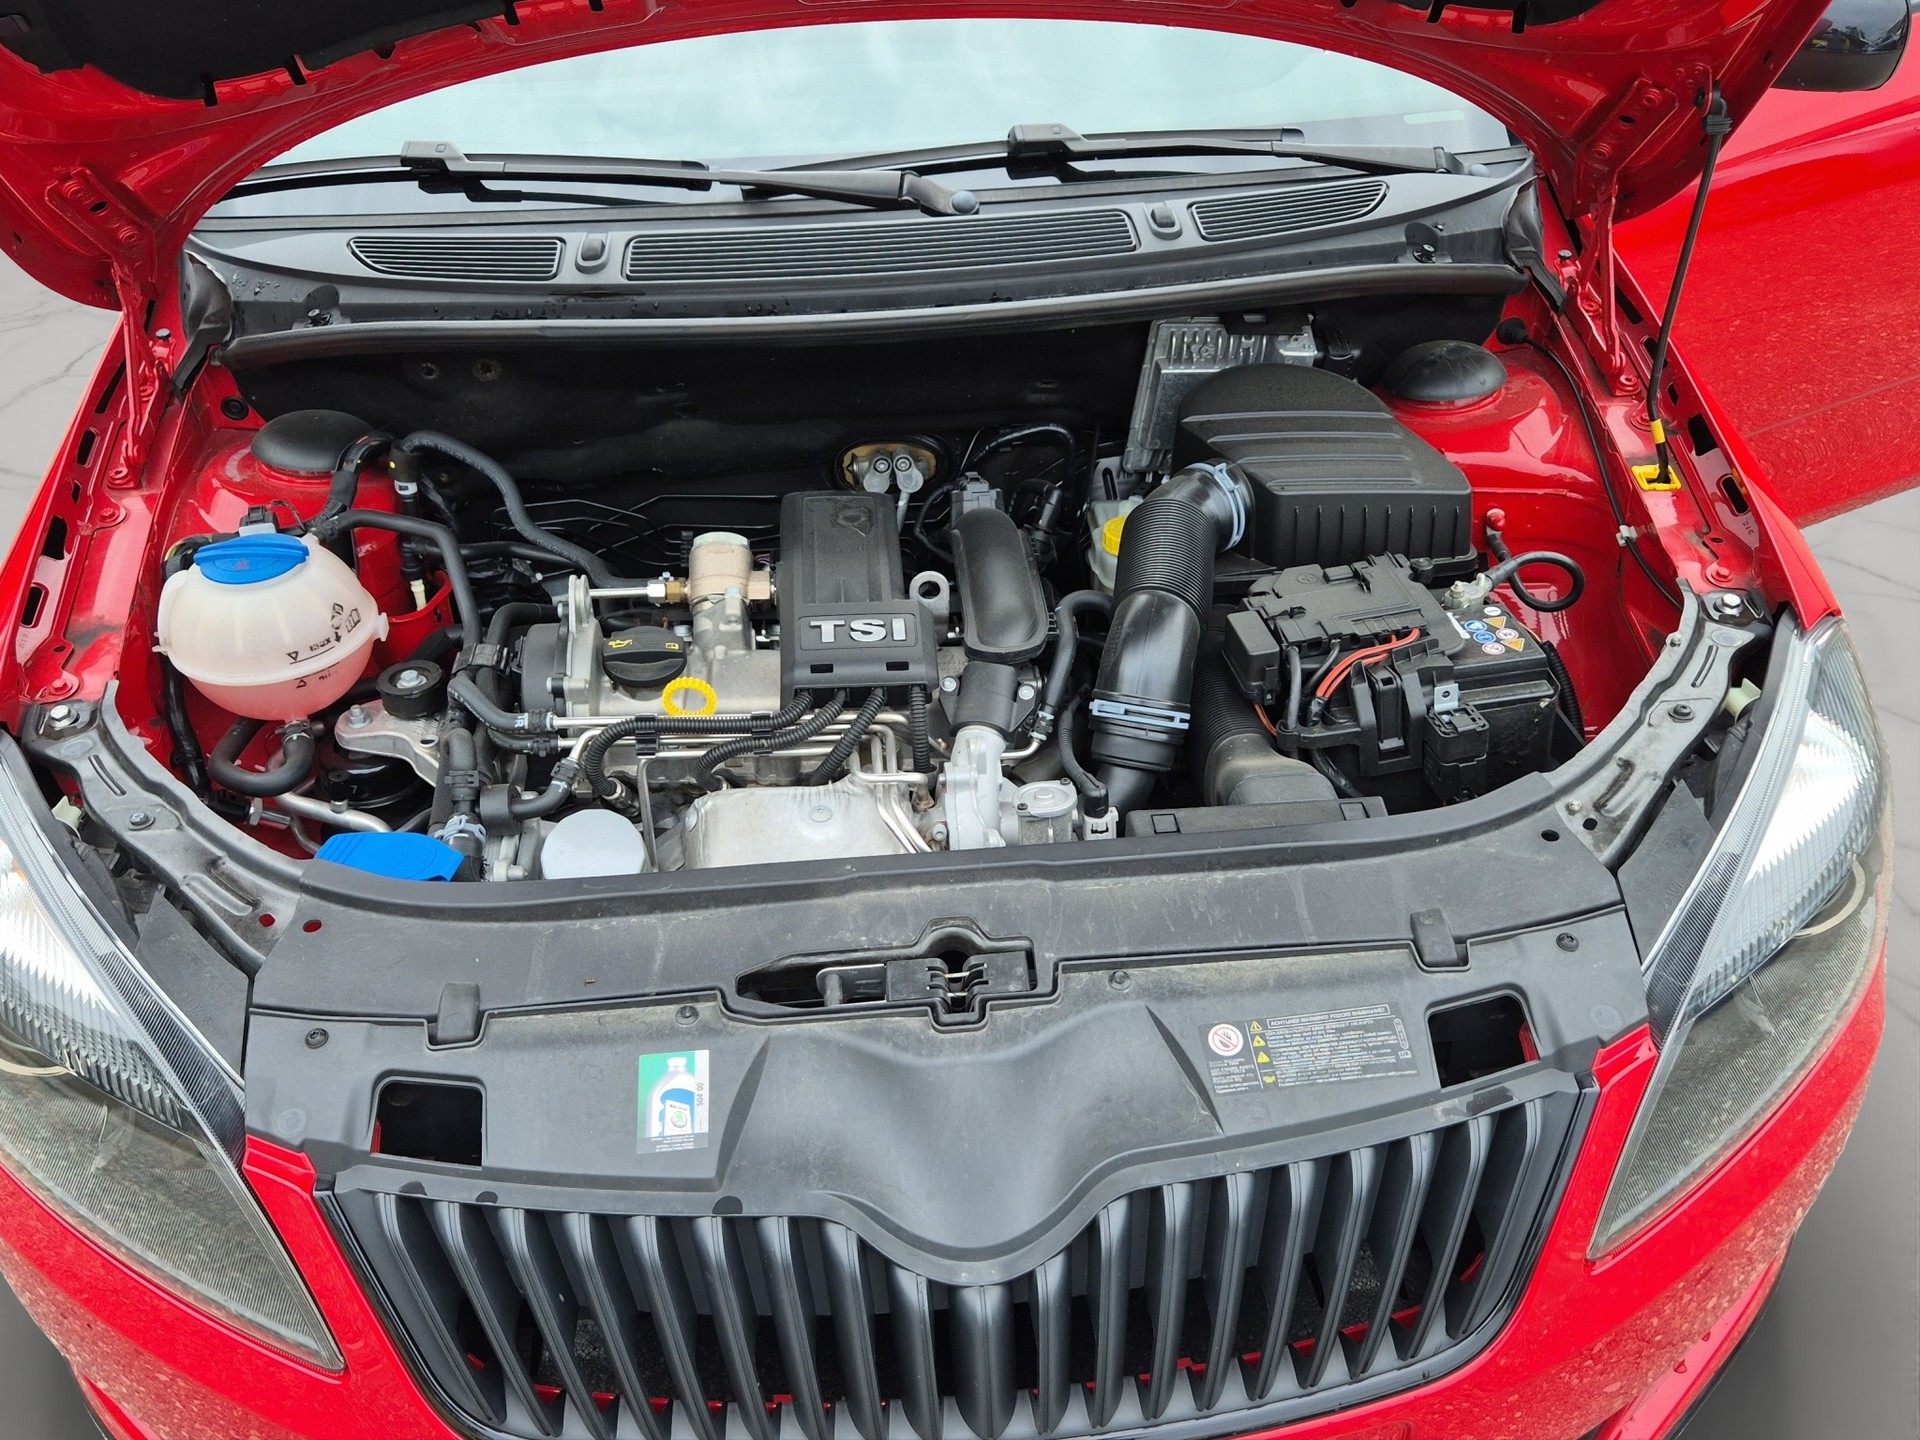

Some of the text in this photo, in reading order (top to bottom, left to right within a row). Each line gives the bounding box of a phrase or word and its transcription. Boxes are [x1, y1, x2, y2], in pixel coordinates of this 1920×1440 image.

[809, 618, 906, 643] TSI
[1270, 1018, 1300, 1026] ACHTUNG!
[696, 1082, 704, 1107] 504 00
